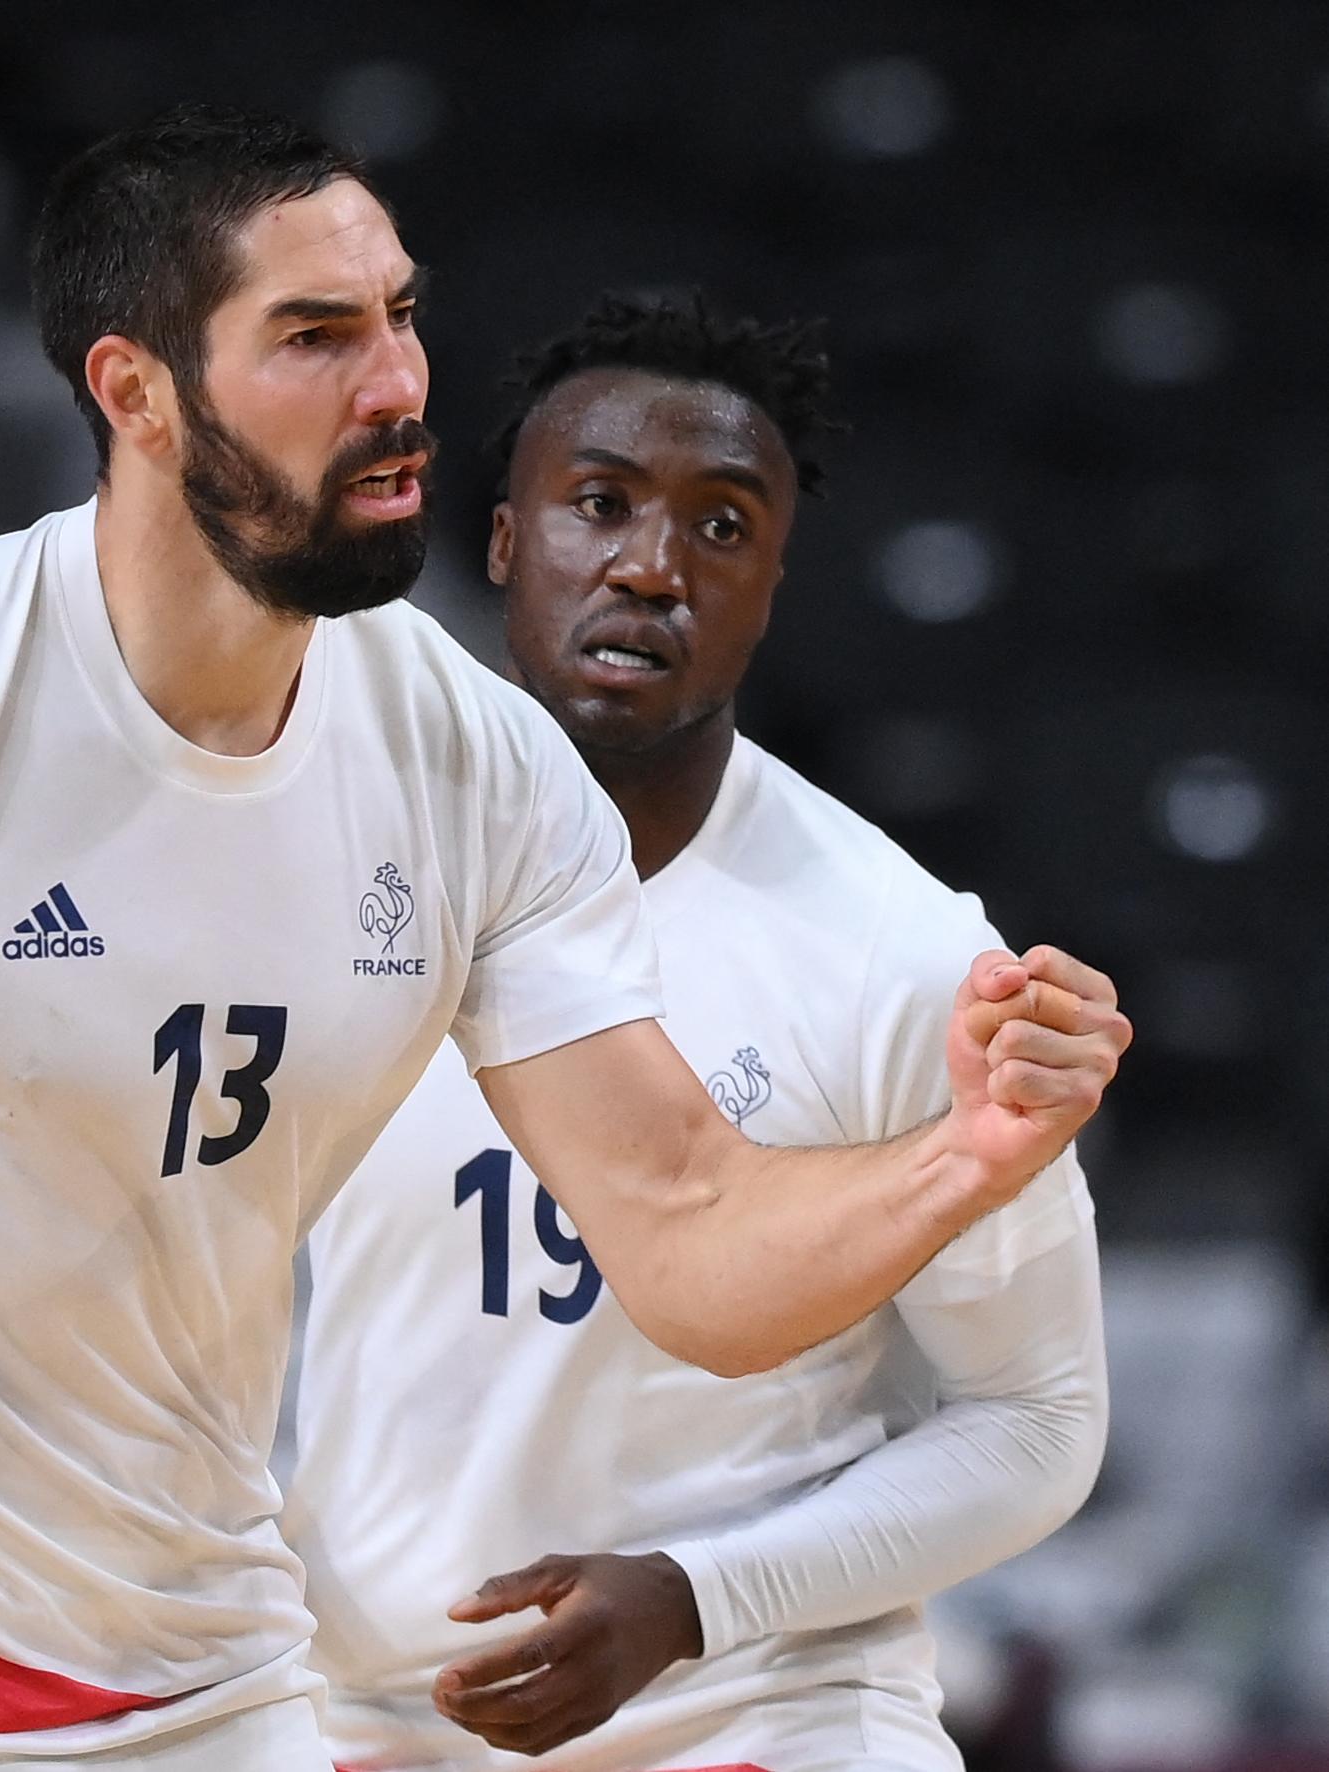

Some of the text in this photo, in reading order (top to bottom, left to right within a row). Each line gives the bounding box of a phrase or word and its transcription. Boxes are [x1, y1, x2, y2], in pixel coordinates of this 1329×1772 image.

[2, 931, 105, 960] adidas
[353, 958, 426, 976] FRANCE
[153, 1003, 288, 1178] 13
[454, 1148, 603, 1325] 19
